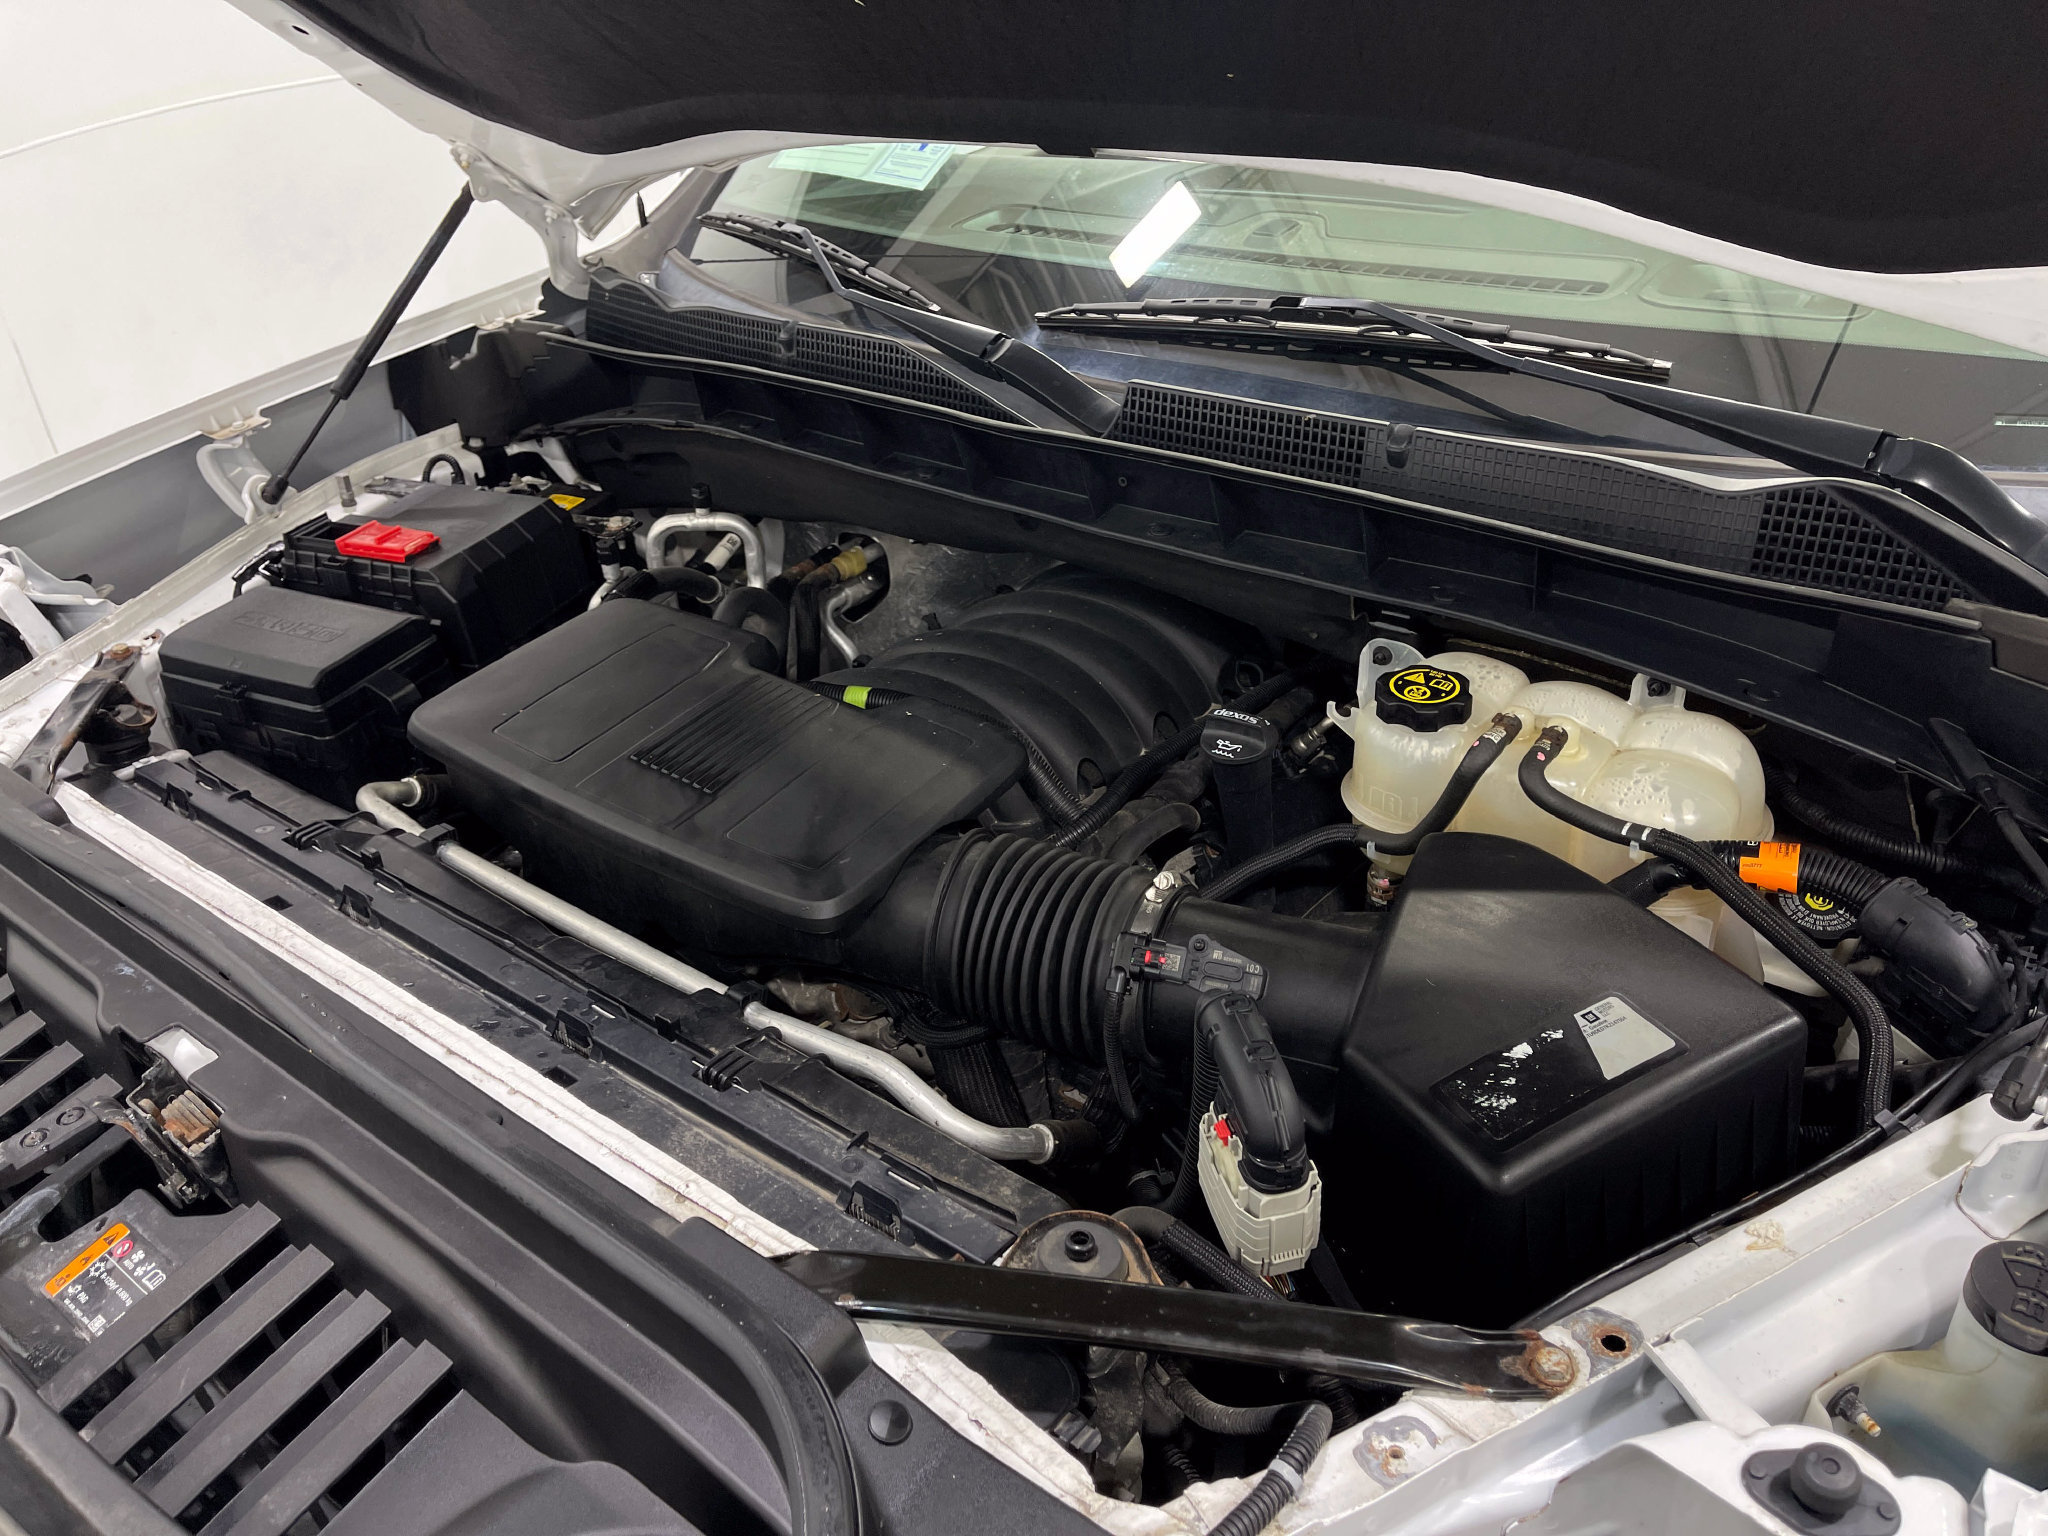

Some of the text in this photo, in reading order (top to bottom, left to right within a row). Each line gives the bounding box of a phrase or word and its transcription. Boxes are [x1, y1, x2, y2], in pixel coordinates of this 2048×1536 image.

[1213, 708, 1259, 725] dexos
[1245, 963, 1260, 974] C01
[123, 1258, 135, 1271] AUTO
[77, 1291, 89, 1304] PAG
